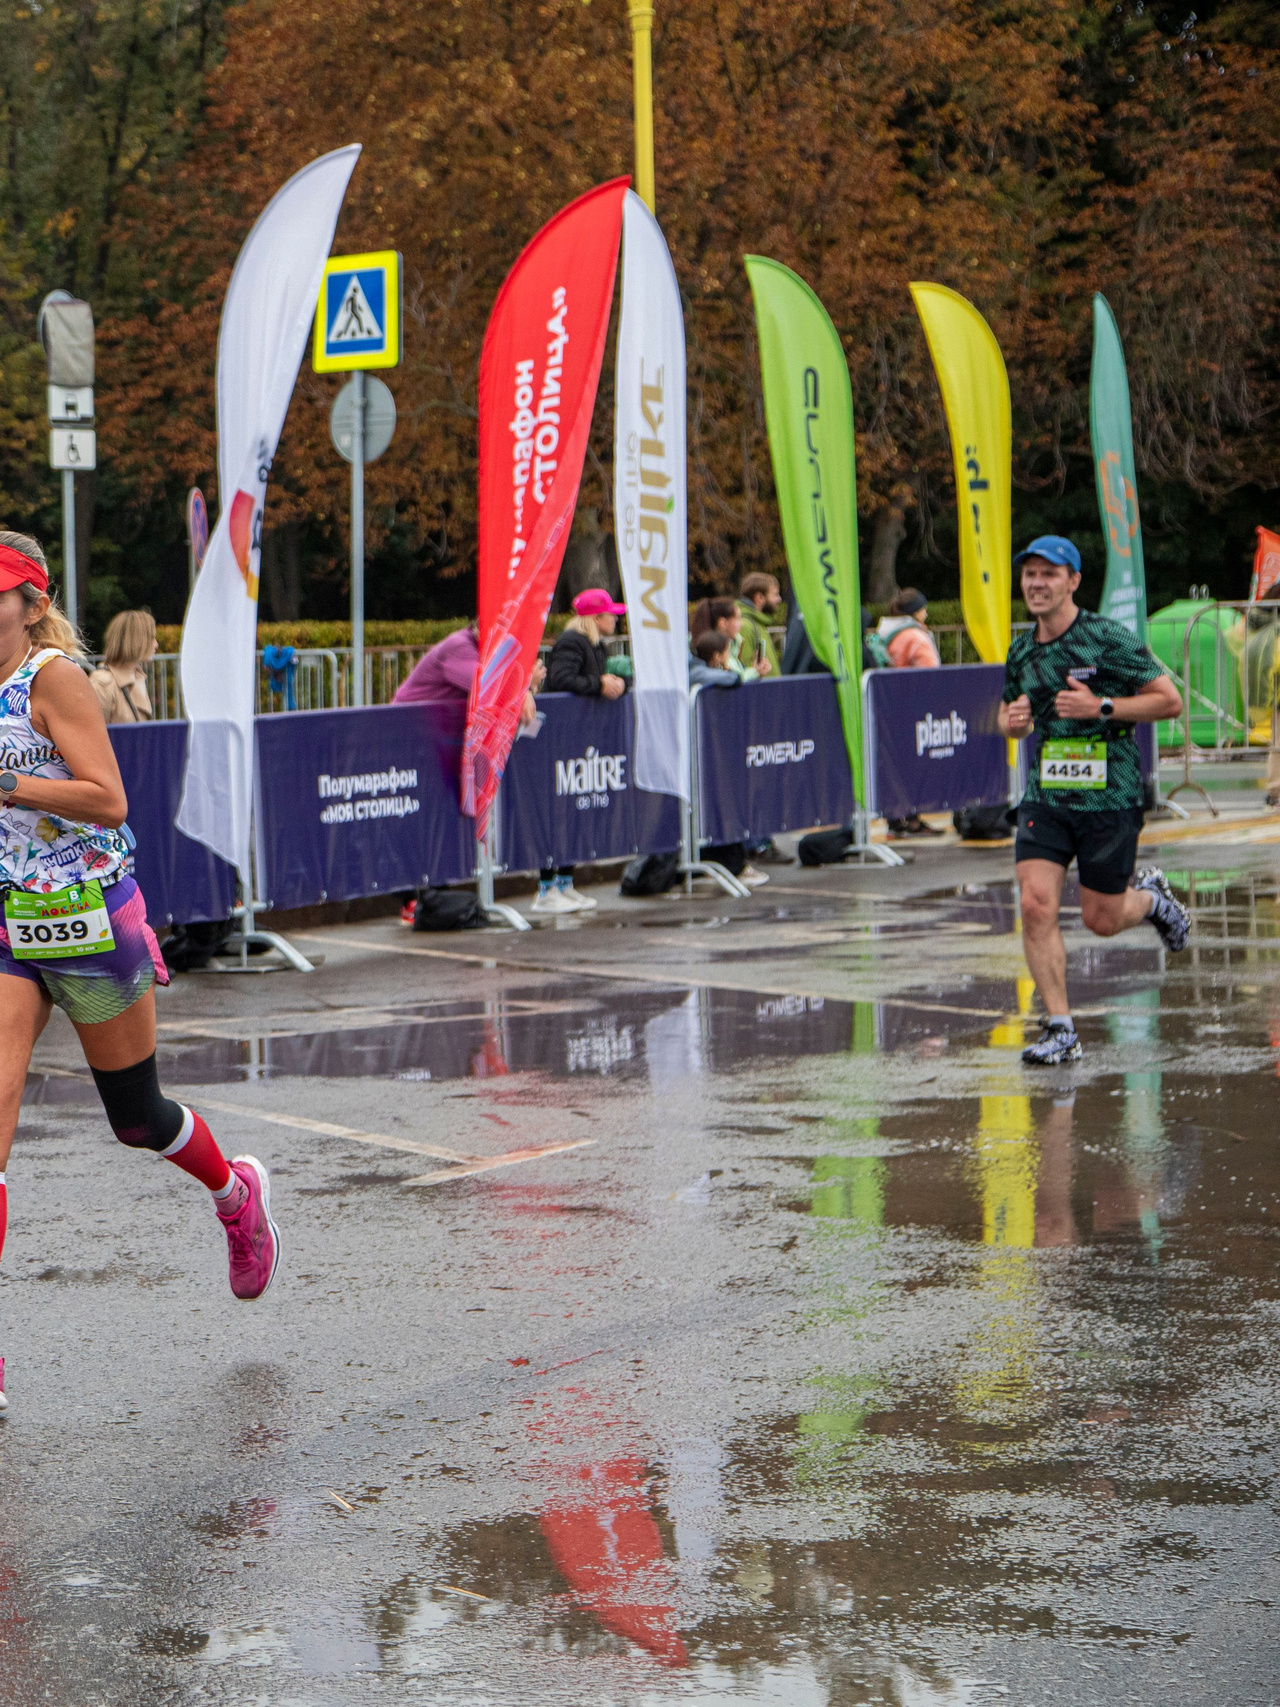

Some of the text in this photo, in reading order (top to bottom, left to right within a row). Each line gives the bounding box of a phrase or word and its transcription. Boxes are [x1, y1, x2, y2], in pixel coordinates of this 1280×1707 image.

[915, 712, 951, 757] plan
[746, 739, 815, 768] POWERUP
[318, 766, 417, 800] Полумарафон
[1047, 763, 1092, 777] 4454
[354, 795, 420, 821] СТОЛИЦА»
[16, 920, 89, 943] 3039
